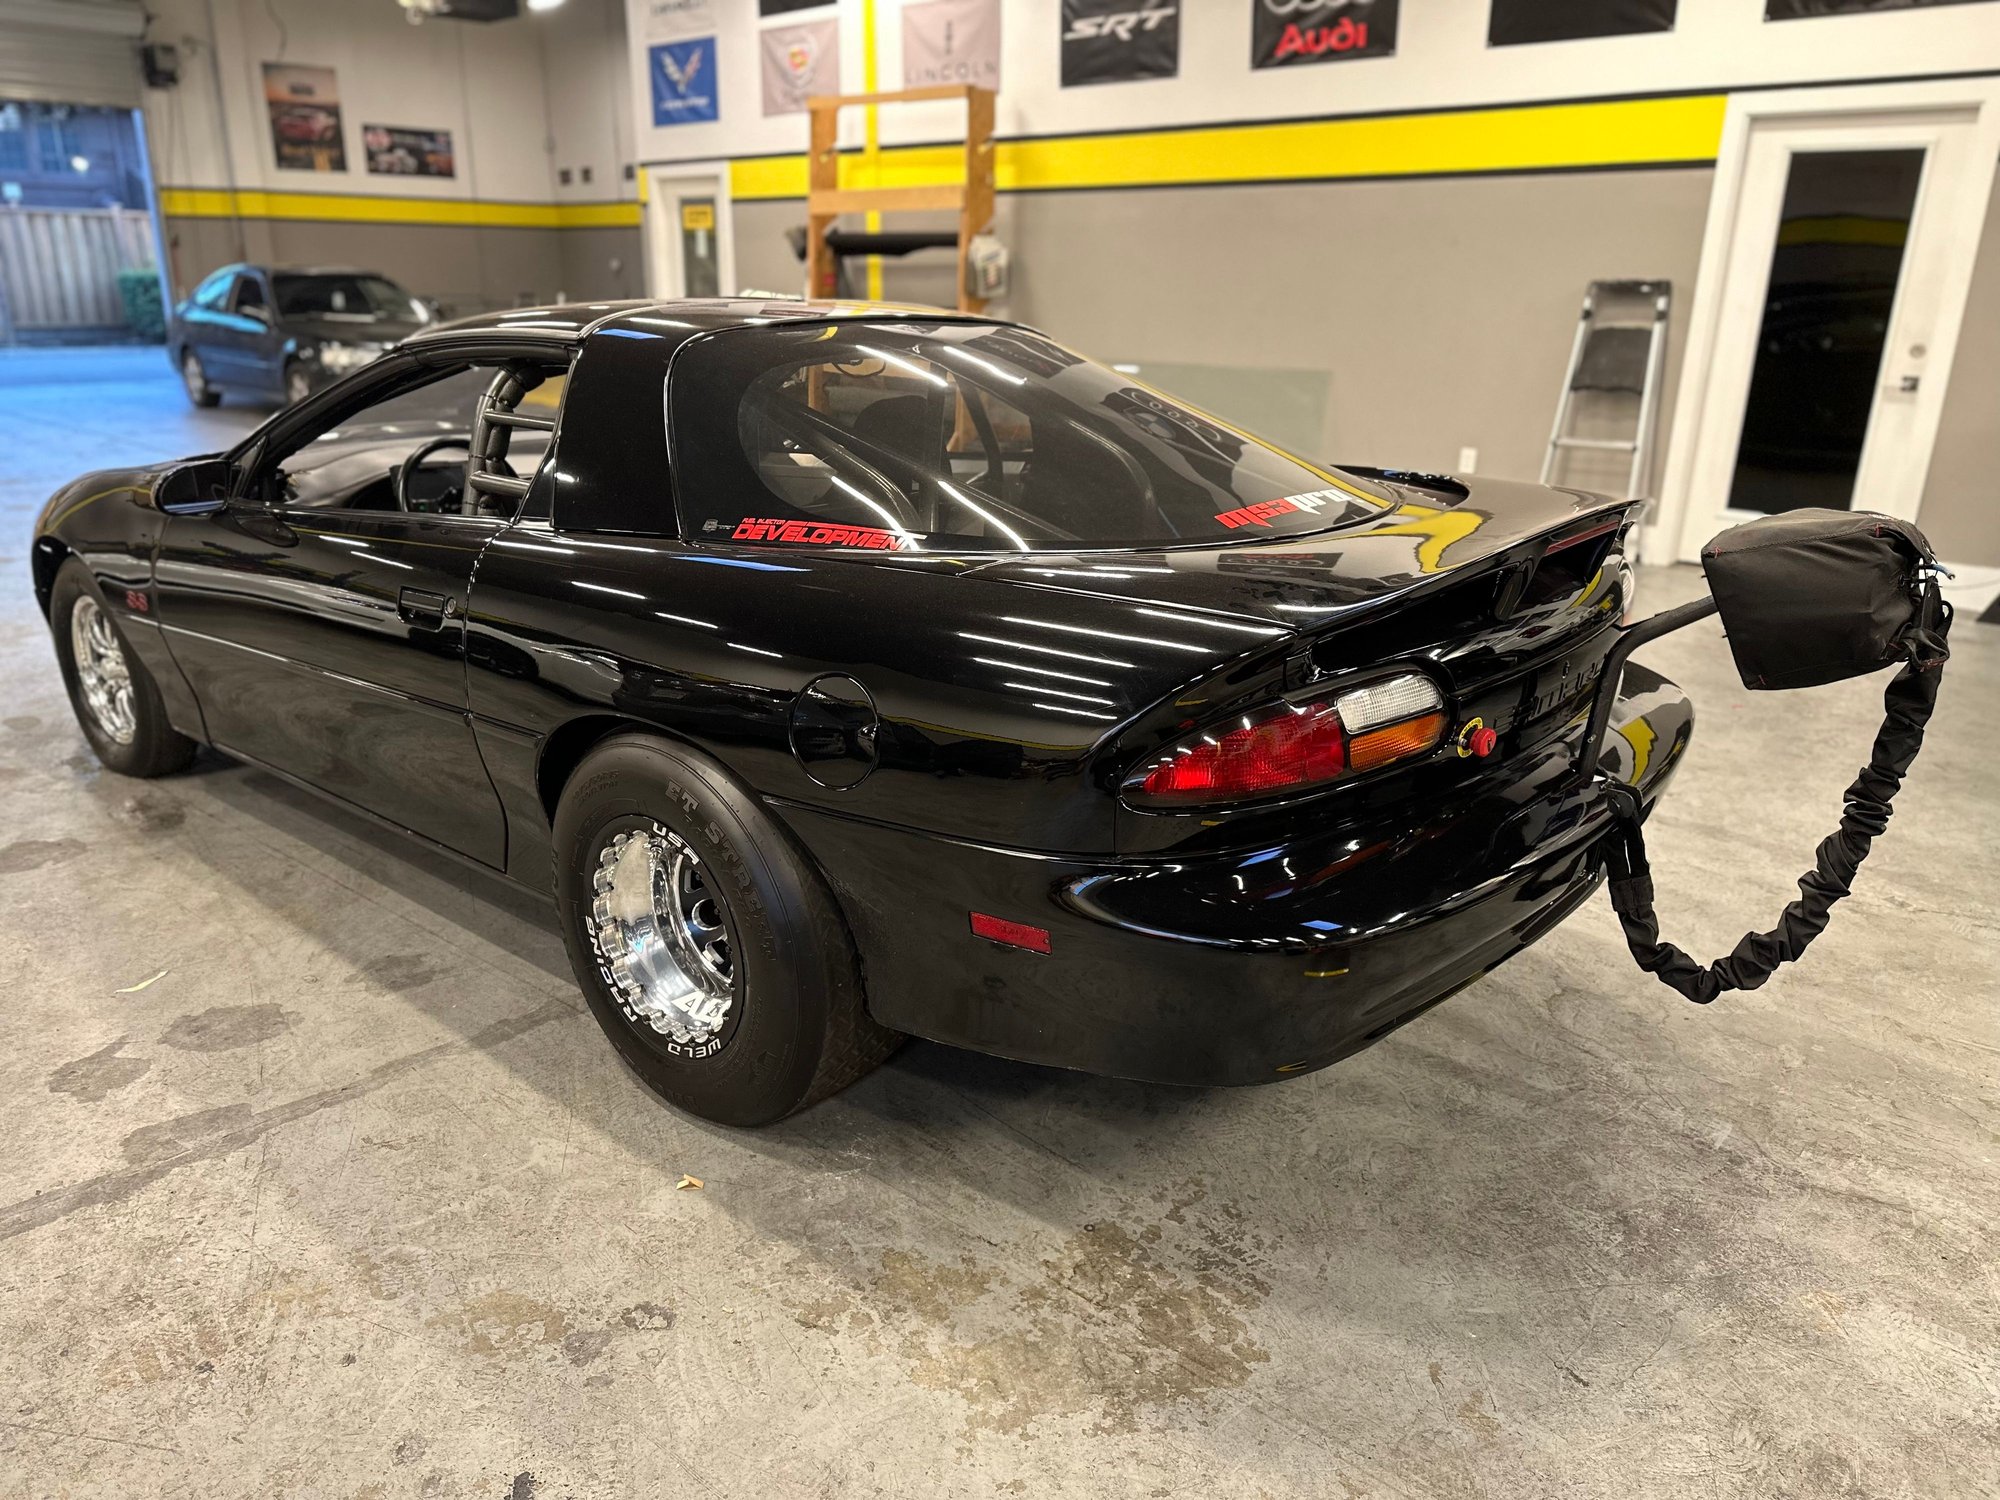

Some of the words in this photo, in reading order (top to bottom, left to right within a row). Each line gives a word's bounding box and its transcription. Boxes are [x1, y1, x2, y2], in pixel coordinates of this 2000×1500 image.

[1063, 7, 1177, 41] SRT
[1274, 17, 1368, 58] Audi
[652, 821, 700, 866] USA
[585, 915, 638, 1023] RACING
[667, 1038, 722, 1058] WELD
